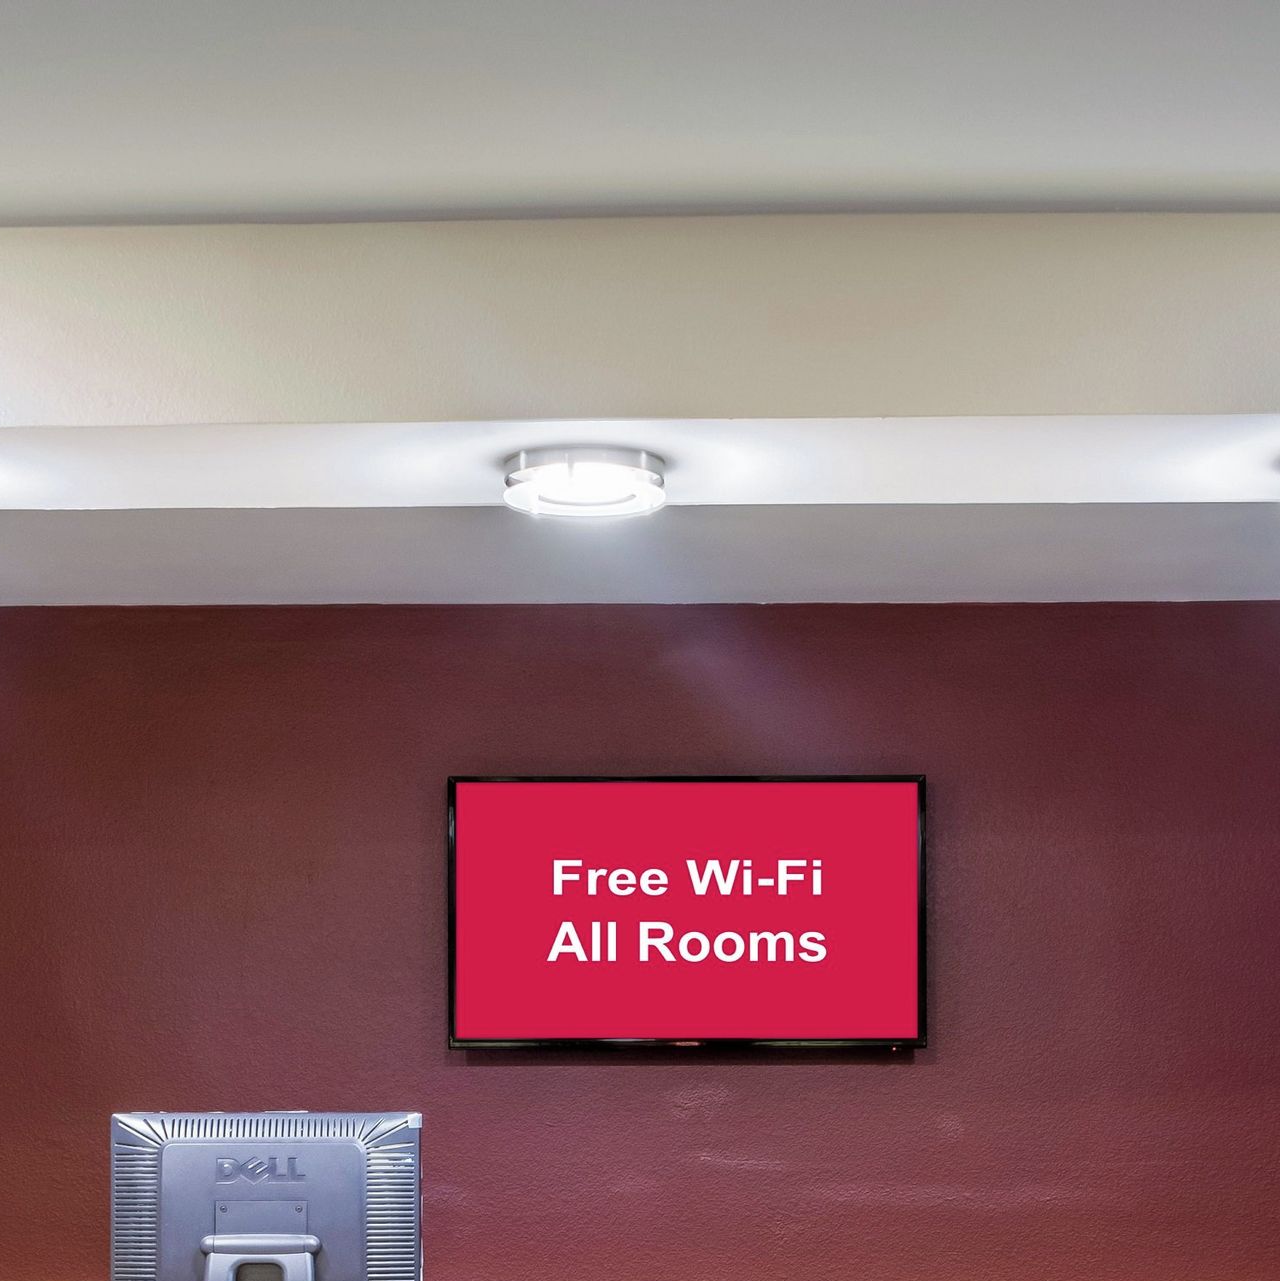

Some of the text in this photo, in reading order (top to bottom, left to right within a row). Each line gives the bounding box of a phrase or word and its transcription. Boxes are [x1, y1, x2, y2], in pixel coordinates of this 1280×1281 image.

[554, 859, 822, 896] Free Wi-Fi
[547, 921, 827, 963] All Rooms
[215, 1156, 306, 1185] DELL
